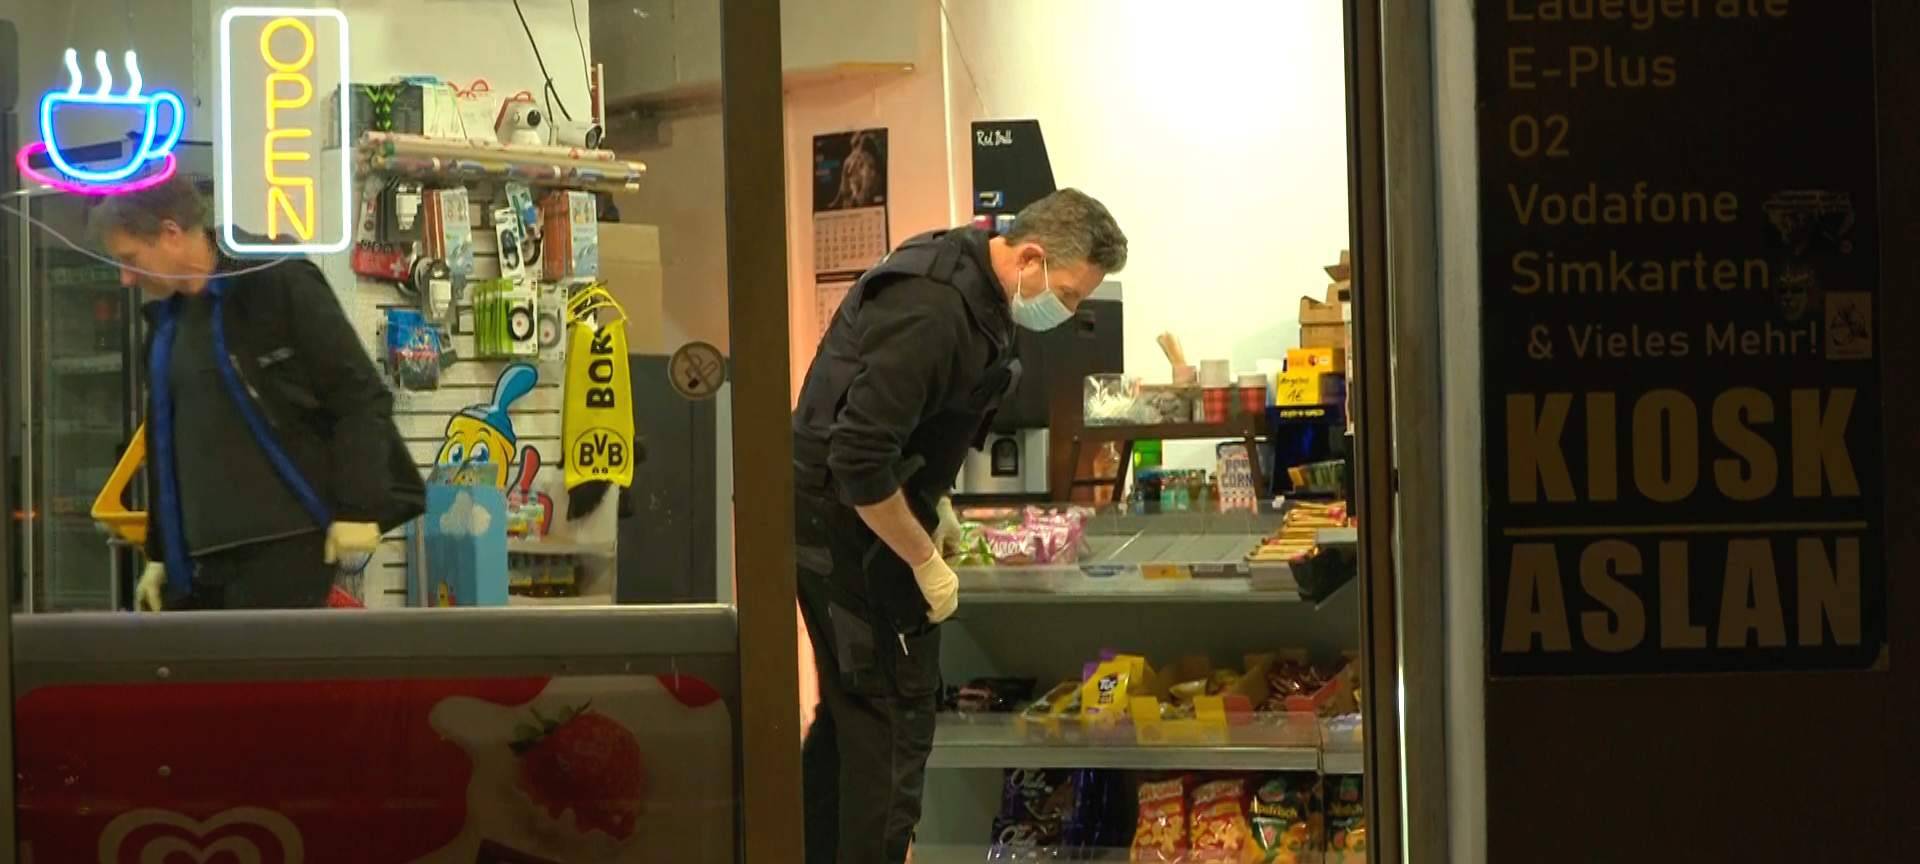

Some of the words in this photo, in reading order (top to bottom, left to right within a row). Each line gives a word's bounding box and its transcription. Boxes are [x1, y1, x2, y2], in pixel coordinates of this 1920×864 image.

[1507, 46, 1677, 89] E-Plus
[260, 17, 315, 240] OPEN
[1507, 181, 1738, 225] Vodafone
[1511, 250, 1769, 294] Simkarten
[1527, 323, 1553, 360] &
[1568, 323, 1689, 360] Vieles
[1706, 320, 1817, 357] Mehr!
[579, 434, 623, 467] BVB
[1505, 387, 1862, 503] KIOSK
[1501, 537, 1862, 653] ASLAN
